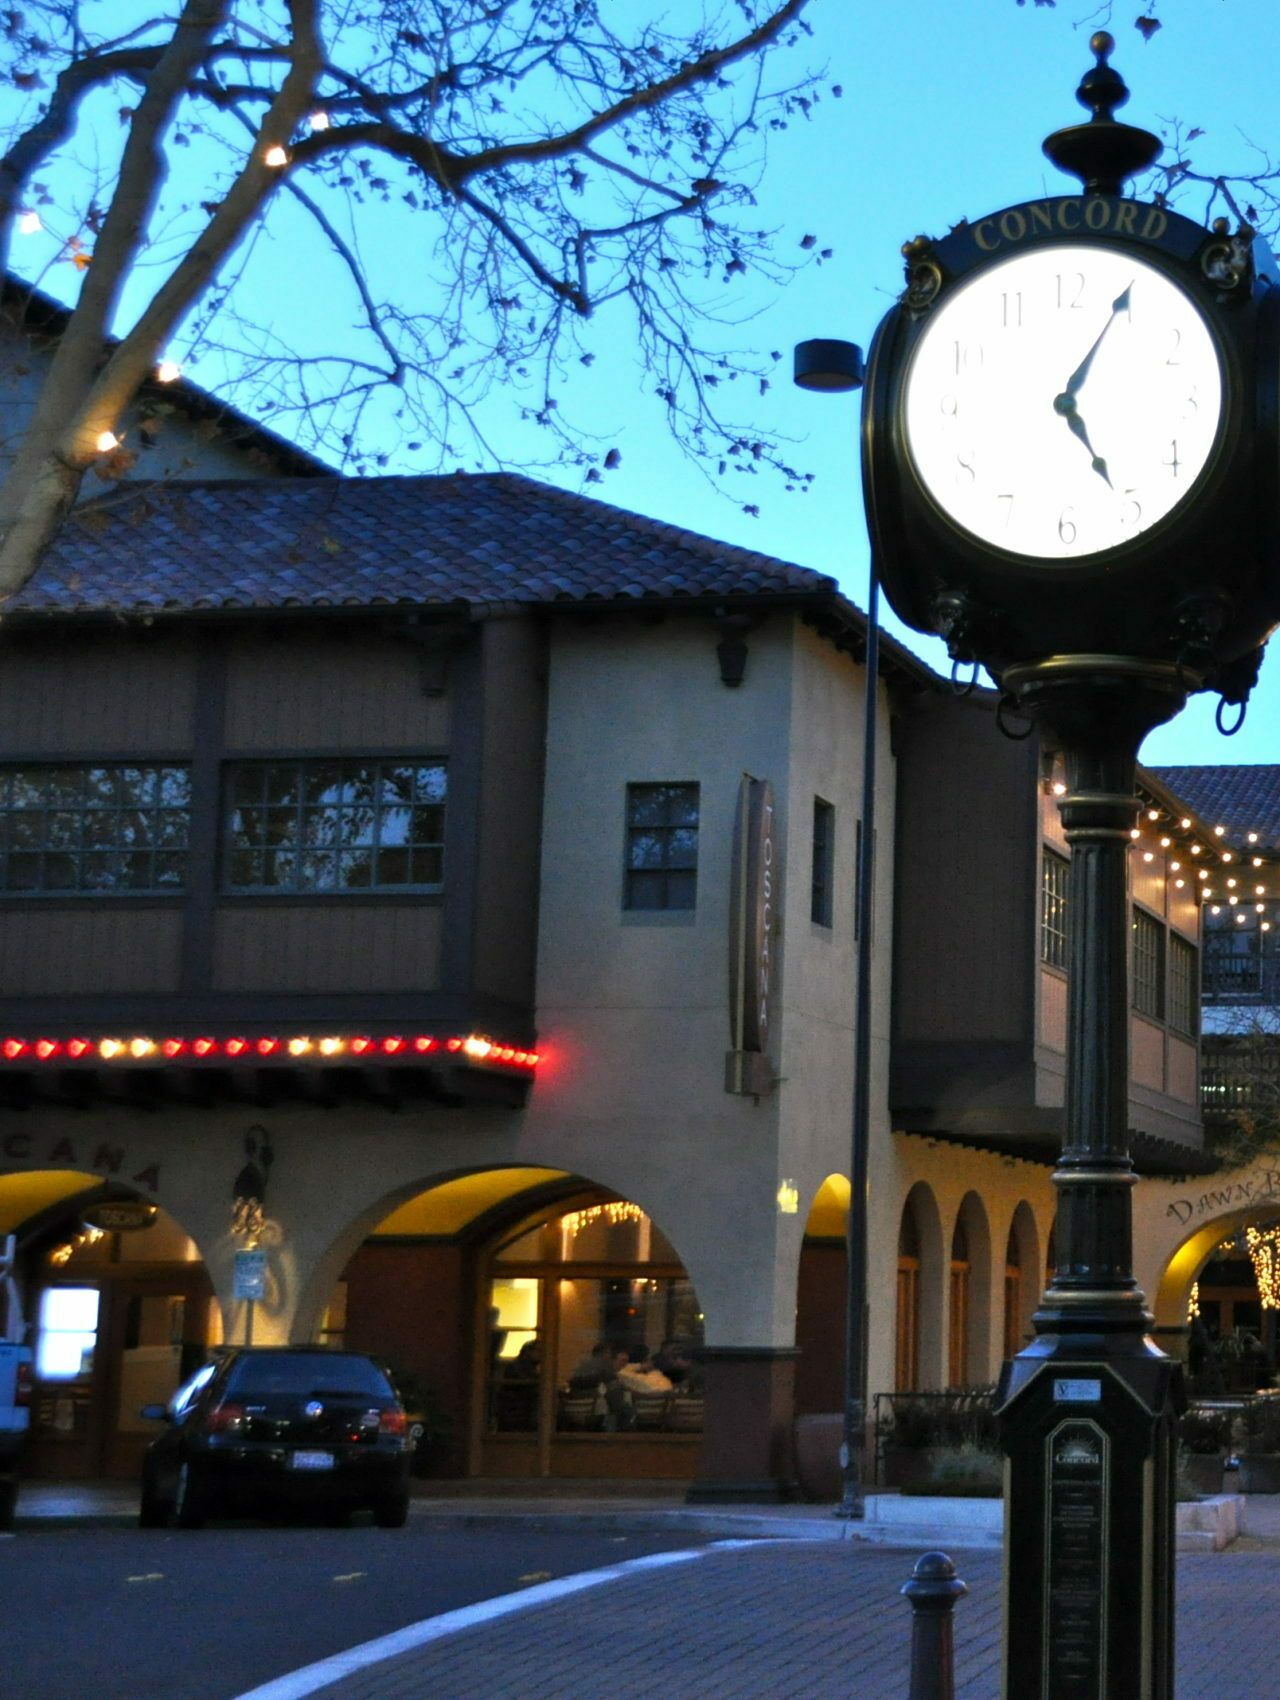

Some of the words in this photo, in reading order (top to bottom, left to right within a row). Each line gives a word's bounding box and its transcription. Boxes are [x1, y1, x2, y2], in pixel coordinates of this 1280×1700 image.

[973, 199, 1168, 251] CONCORD
[1001, 291, 1024, 328] 11
[1054, 272, 1086, 309] 12
[954, 340, 984, 376] 10
[1165, 328, 1181, 366] 2
[1161, 438, 1183, 478] 4
[996, 493, 1015, 529] 7
[1057, 505, 1077, 545] 6
[759, 805, 773, 1027] TOSCANA
